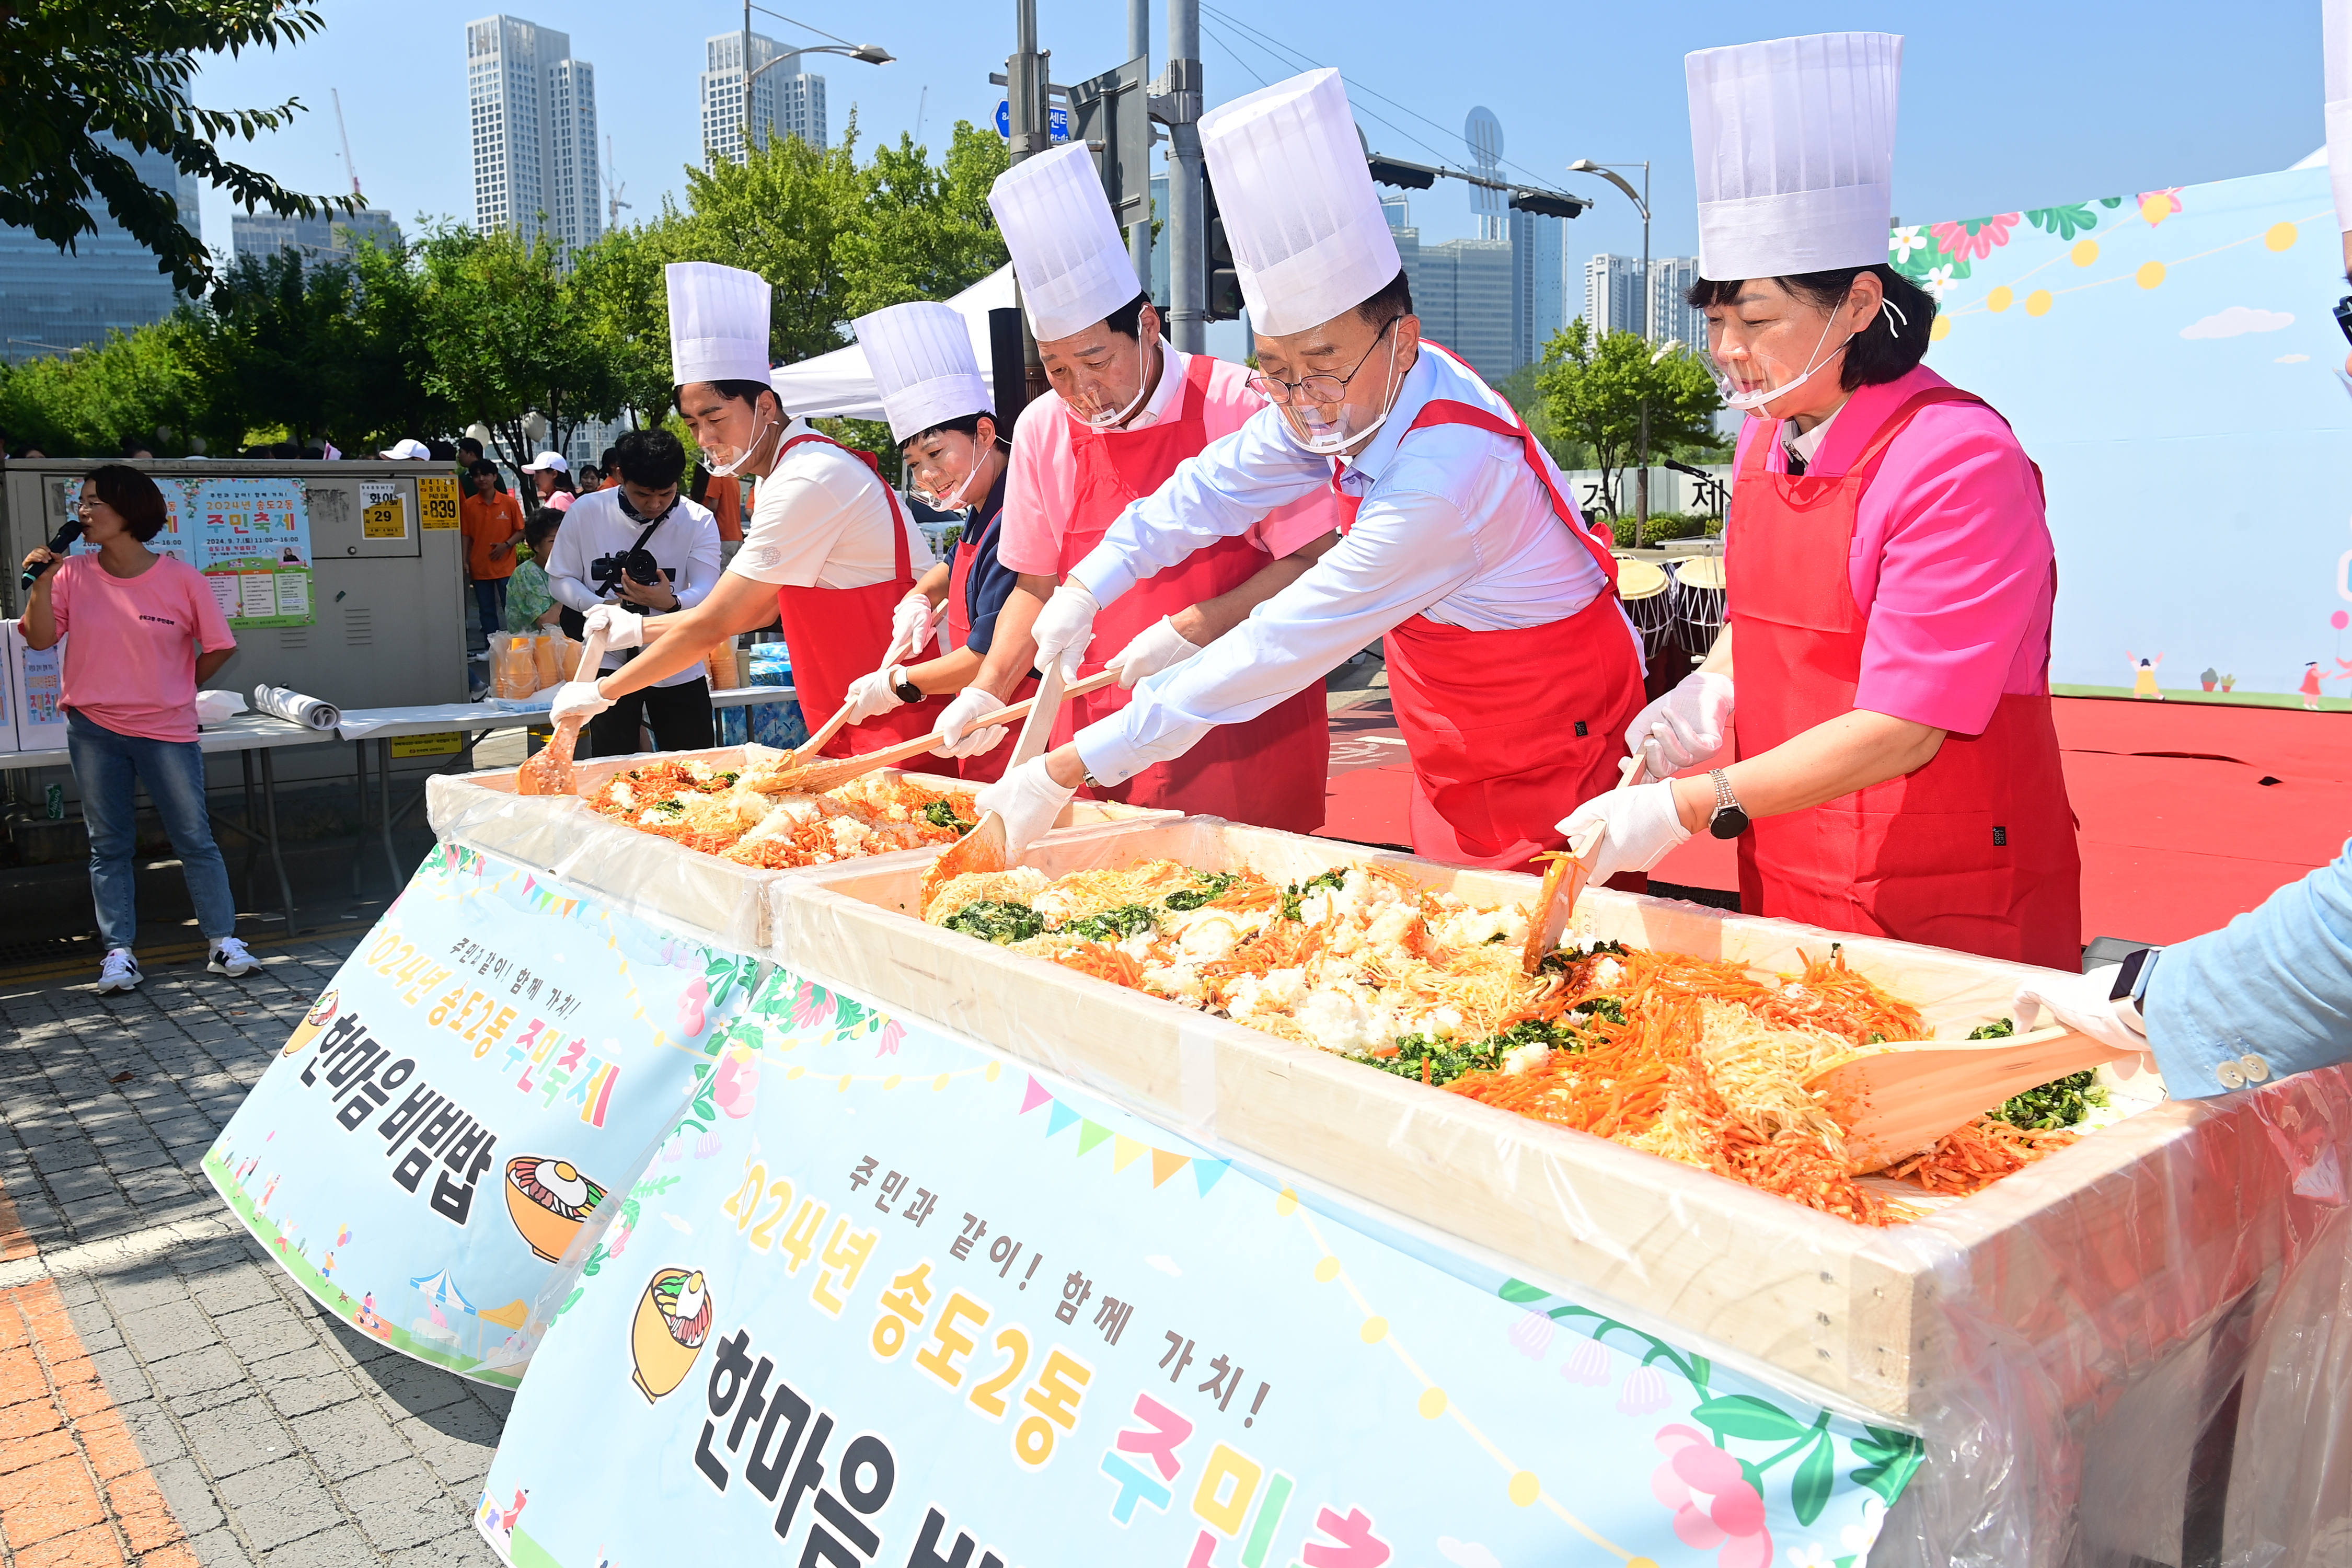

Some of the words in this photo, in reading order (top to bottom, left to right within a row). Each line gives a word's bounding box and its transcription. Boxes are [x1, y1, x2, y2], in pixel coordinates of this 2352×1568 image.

[206, 501, 251, 510] 2024년
[256, 500, 293, 511] 송도2동
[207, 512, 295, 534] 주민축제
[374, 510, 391, 522] 29
[430, 500, 456, 518] 839
[478, 952, 514, 983] 같이!
[510, 968, 544, 1000] 함께
[546, 988, 581, 1020] 가치!
[428, 981, 518, 1058] 송도2동
[501, 1018, 620, 1127] 주민축제
[300, 1012, 416, 1132] 한마음
[377, 1082, 498, 1225] 비빔밥
[723, 1152, 878, 1315] 2024년
[872, 1263, 1091, 1465] 송도2동
[849, 1155, 939, 1229] 주민과
[949, 1212, 1043, 1291] 같이!
[1055, 1270, 1134, 1347] 함께
[1158, 1329, 1271, 1428] 가치!
[695, 1329, 895, 1568] 한마음
